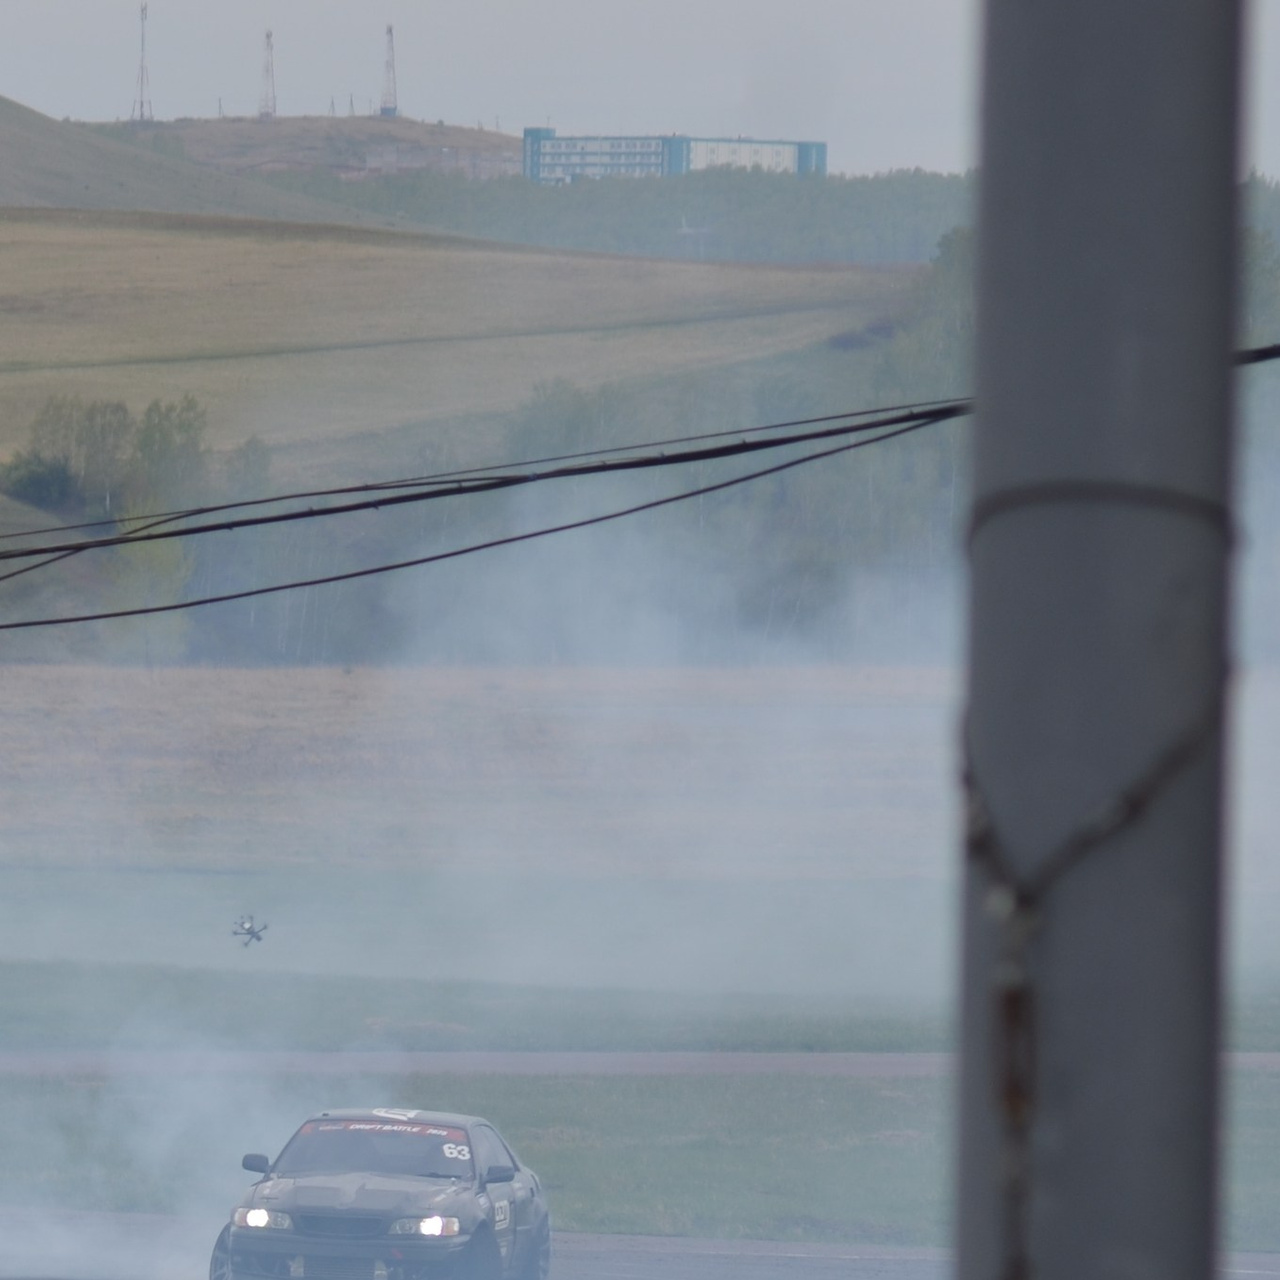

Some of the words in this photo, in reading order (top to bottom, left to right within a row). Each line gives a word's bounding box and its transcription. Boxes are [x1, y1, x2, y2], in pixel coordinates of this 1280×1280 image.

[349, 1123, 382, 1131] DRIFT
[383, 1124, 422, 1133] BATTLE
[443, 1143, 471, 1160] 63
